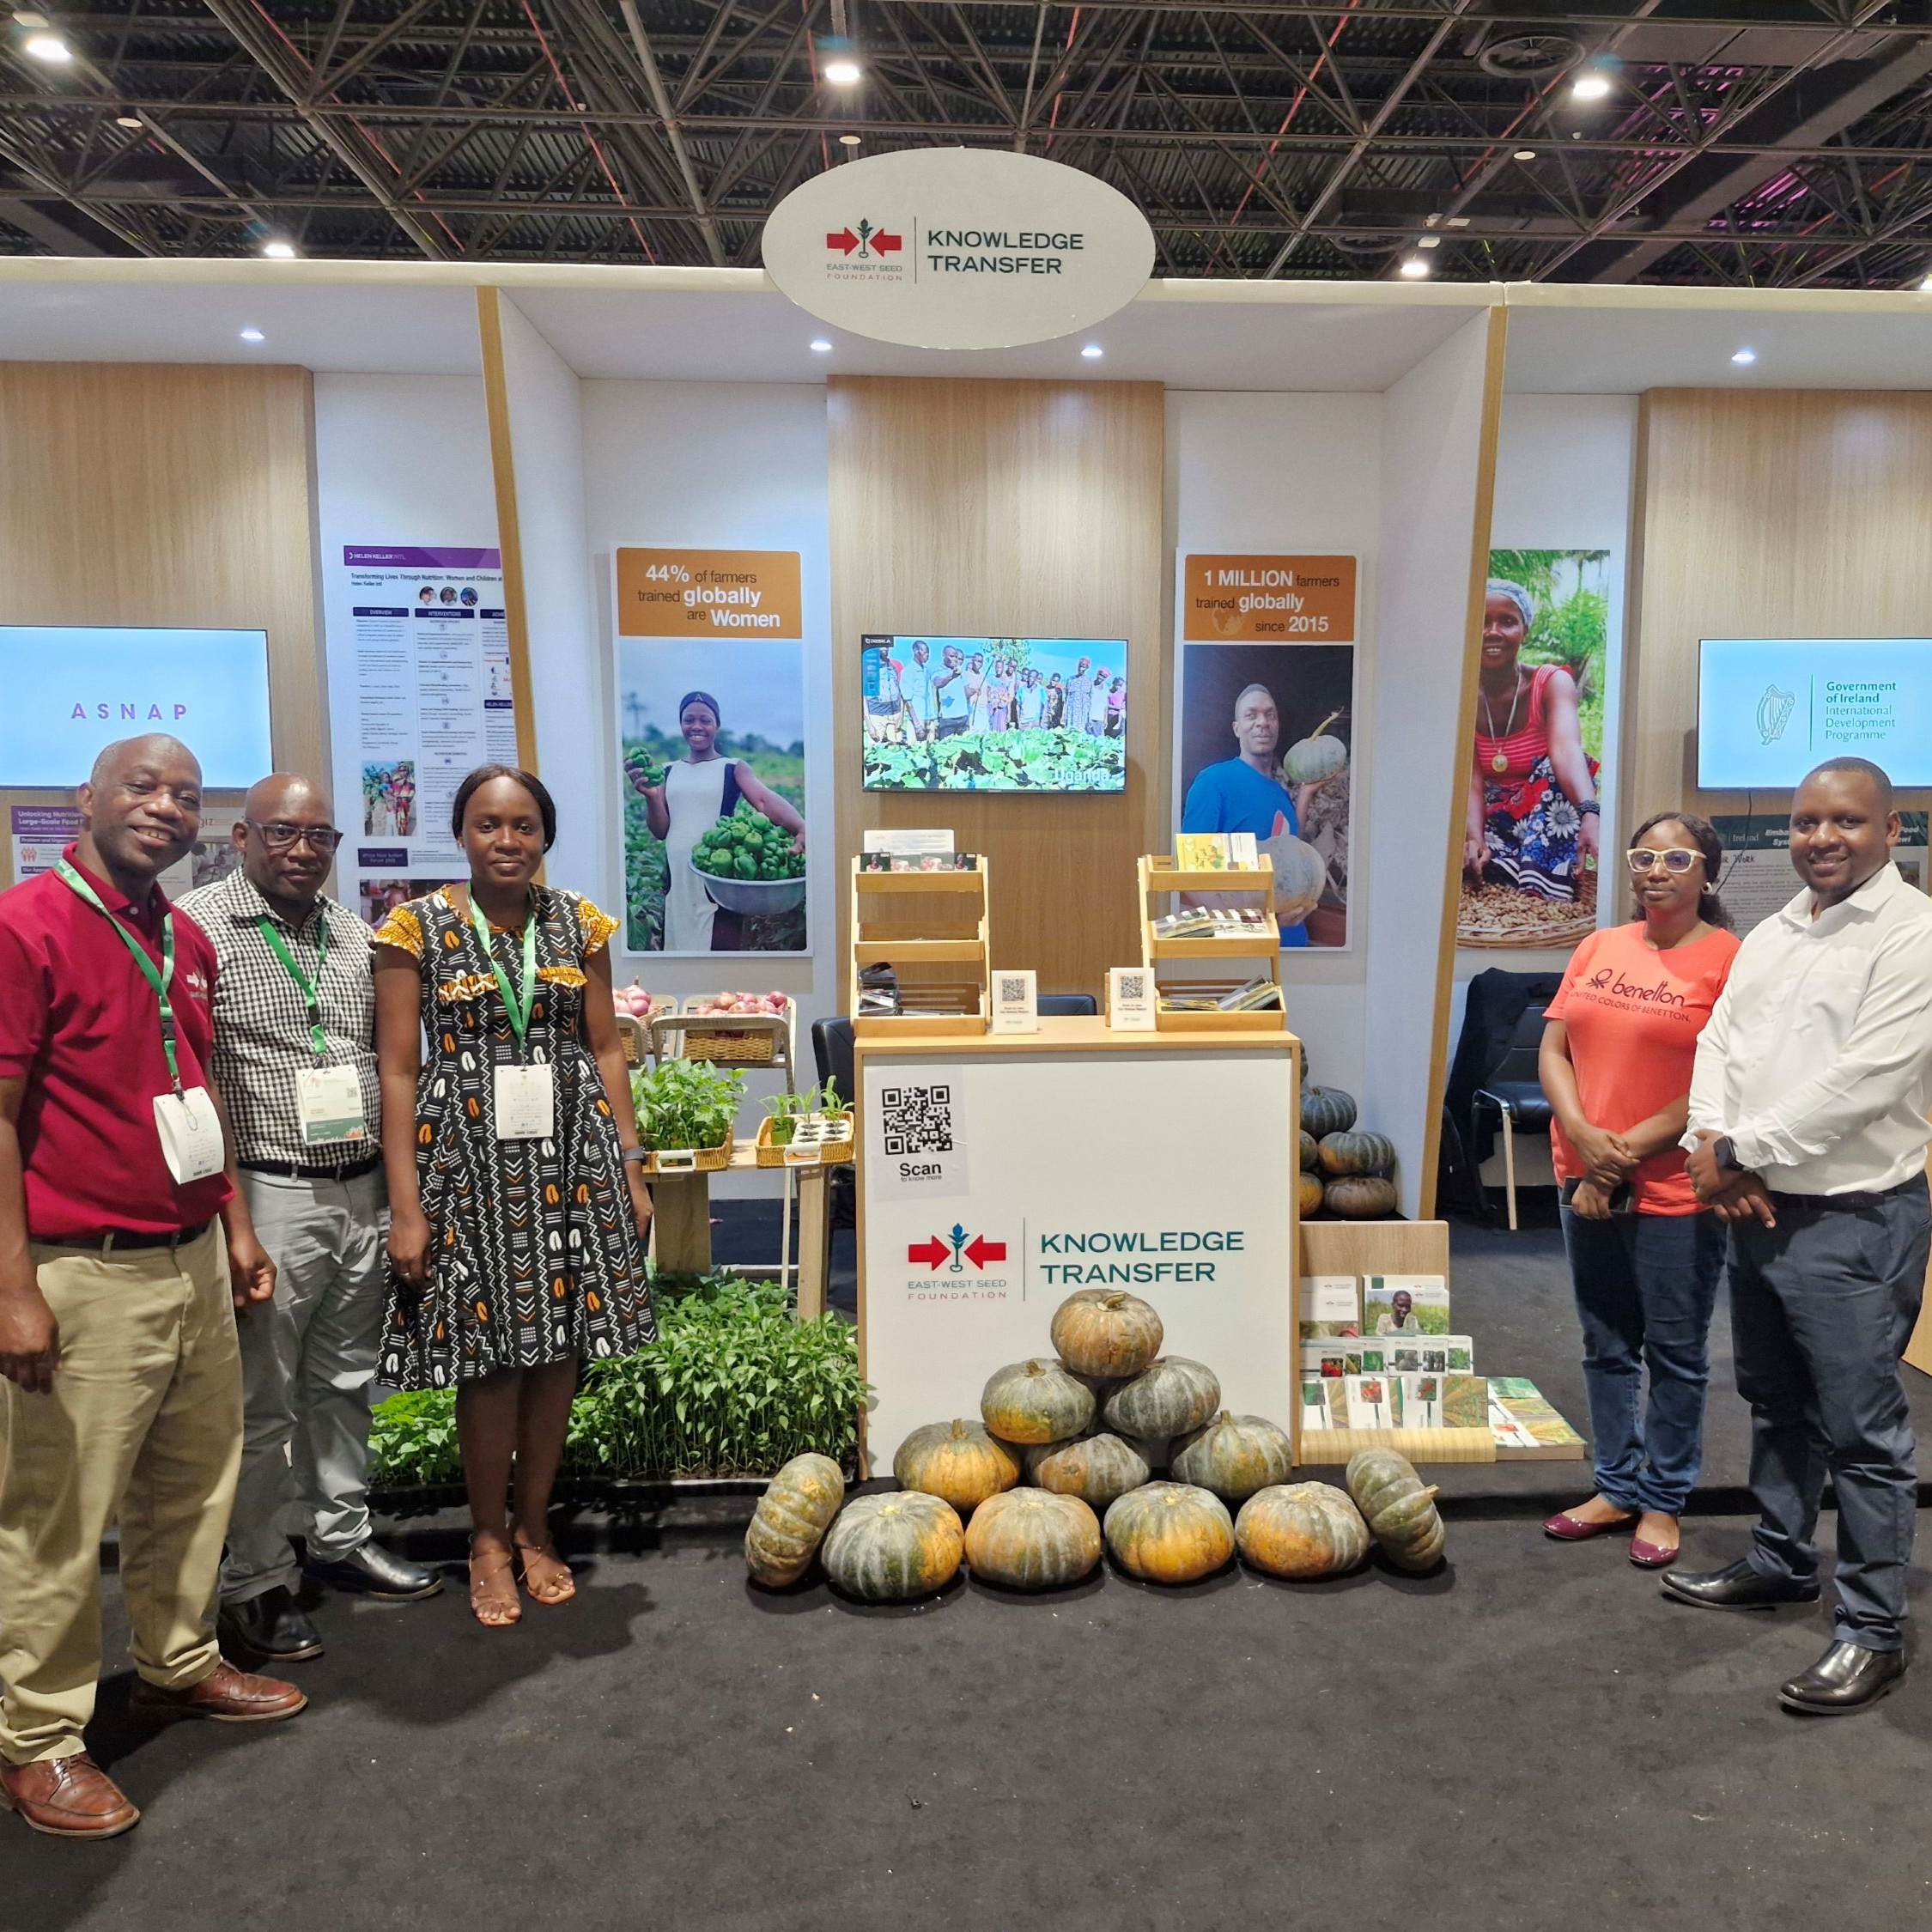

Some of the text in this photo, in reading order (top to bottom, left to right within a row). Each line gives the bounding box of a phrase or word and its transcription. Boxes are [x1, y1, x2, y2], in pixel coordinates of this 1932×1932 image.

[927, 230, 1084, 250] KNOWLEDGE
[826, 263, 903, 273] EAST-WEST SEED
[927, 255, 1062, 274] TRANSFER
[826, 273, 902, 282] FOUNDATION
[351, 572, 385, 580] Transforming
[646, 564, 757, 584] 44% of farmers
[1204, 569, 1340, 587] 1 MILLION farmers
[637, 586, 762, 608] trained globally
[1196, 592, 1304, 612] trained globally
[687, 609, 781, 627] are Women
[1255, 616, 1329, 633] since 2015
[1826, 681, 1897, 691] Government
[1826, 692, 1880, 703] of Ireland
[1826, 704, 1893, 715] International
[1826, 717, 1896, 730] Development
[1826, 729, 1886, 743] Programme
[1054, 769, 1110, 785] Uganda
[1612, 972, 1685, 1007] benetton
[1598, 996, 1631, 1011] COLORS
[1631, 1004, 1642, 1012] OF
[899, 1162, 942, 1176] Scan
[1041, 1231, 1244, 1254] KNOWLEDGE
[1040, 1262, 1216, 1285] TRANSFER
[908, 1279, 1007, 1289] EAST-WEST SEED
[908, 1291, 1006, 1301] FOUNDATION
